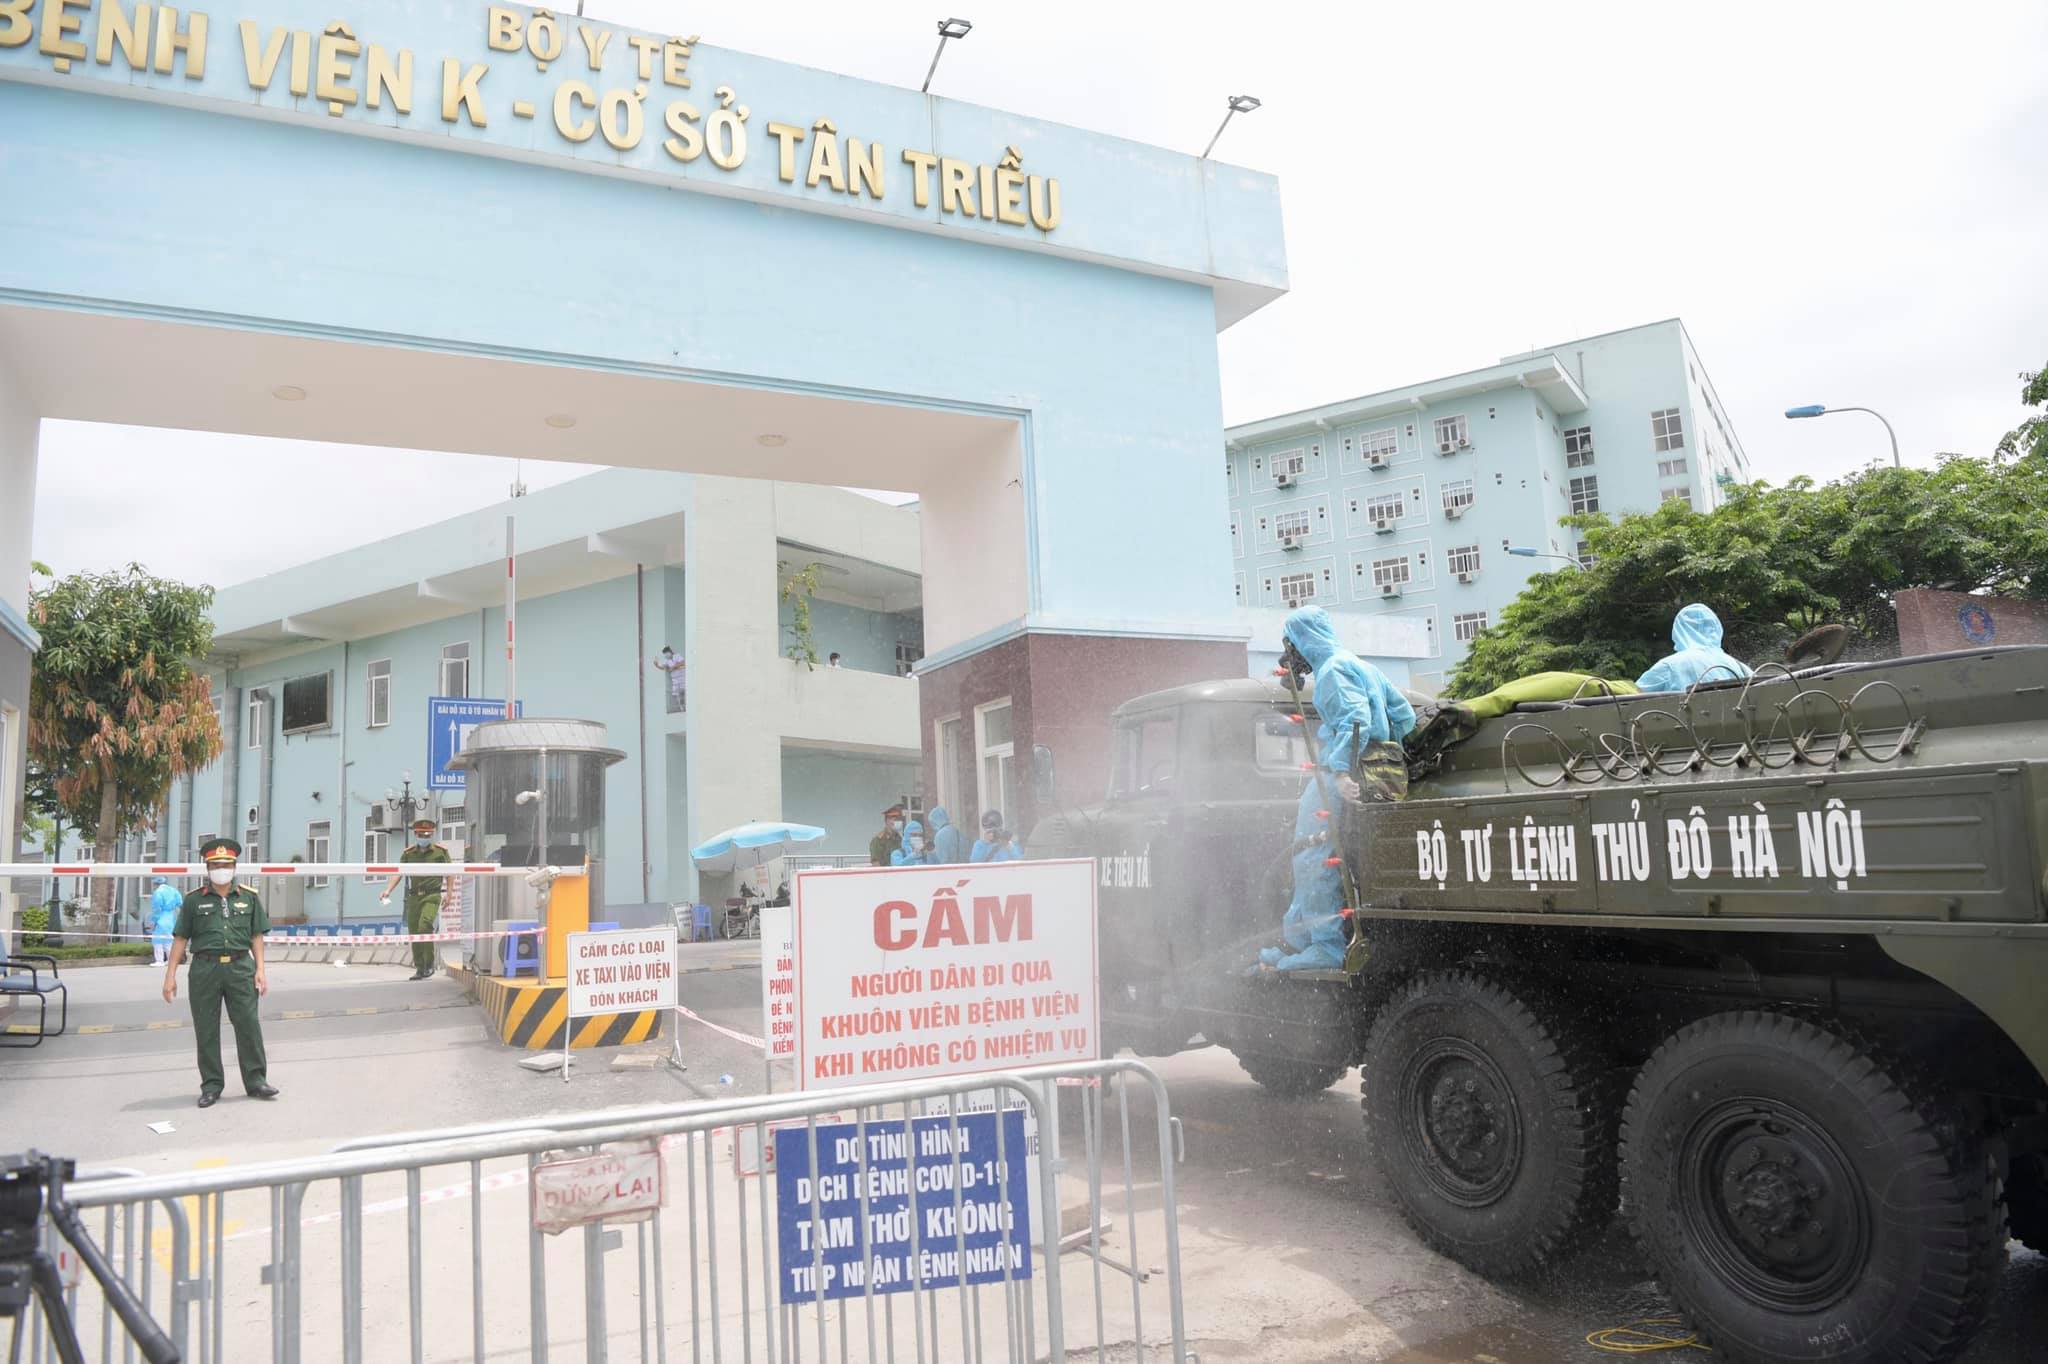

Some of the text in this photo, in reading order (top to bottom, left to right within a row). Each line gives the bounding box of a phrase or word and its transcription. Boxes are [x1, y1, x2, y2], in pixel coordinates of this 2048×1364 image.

[488, 7, 700, 88] BỘ Y TẾ
[239, 19, 414, 116] VIỆN
[441, 56, 490, 128] K
[553, 80, 648, 151] CƠ
[663, 85, 751, 170] SỞ
[767, 116, 884, 200] TÂN
[904, 145, 1061, 232] TRIỀU
[1416, 798, 1867, 891] BỘ TƯ LỆNH THỦ ĐÔ HÀ NỘI
[873, 879, 1033, 952] CẤM
[580, 940, 665, 958] CẤM CÁC LOẠI
[576, 959, 670, 986] XE TAXI VÀO VIỆN
[770, 975, 792, 995] PHÒN
[852, 960, 1052, 998] NGƯỜI DÂN ĐI QUA
[618, 988, 657, 1005] KHÁCH
[821, 990, 1080, 1039] KHUÔN VIÊN BỆNH VIỆN
[814, 1028, 1086, 1078] KHI KHÔNG CÓ NHIỆM VỤ
[836, 1137, 862, 1164] DO
[921, 1124, 969, 1156] HÌNH
[616, 1176, 652, 1200] LẠI
[797, 1175, 847, 1204] DCH
[916, 1160, 1008, 1193] COVD-19
[797, 1199, 1013, 1255] TẠM THỜ KHÔNG
[966, 1241, 1022, 1274] NHÂN
